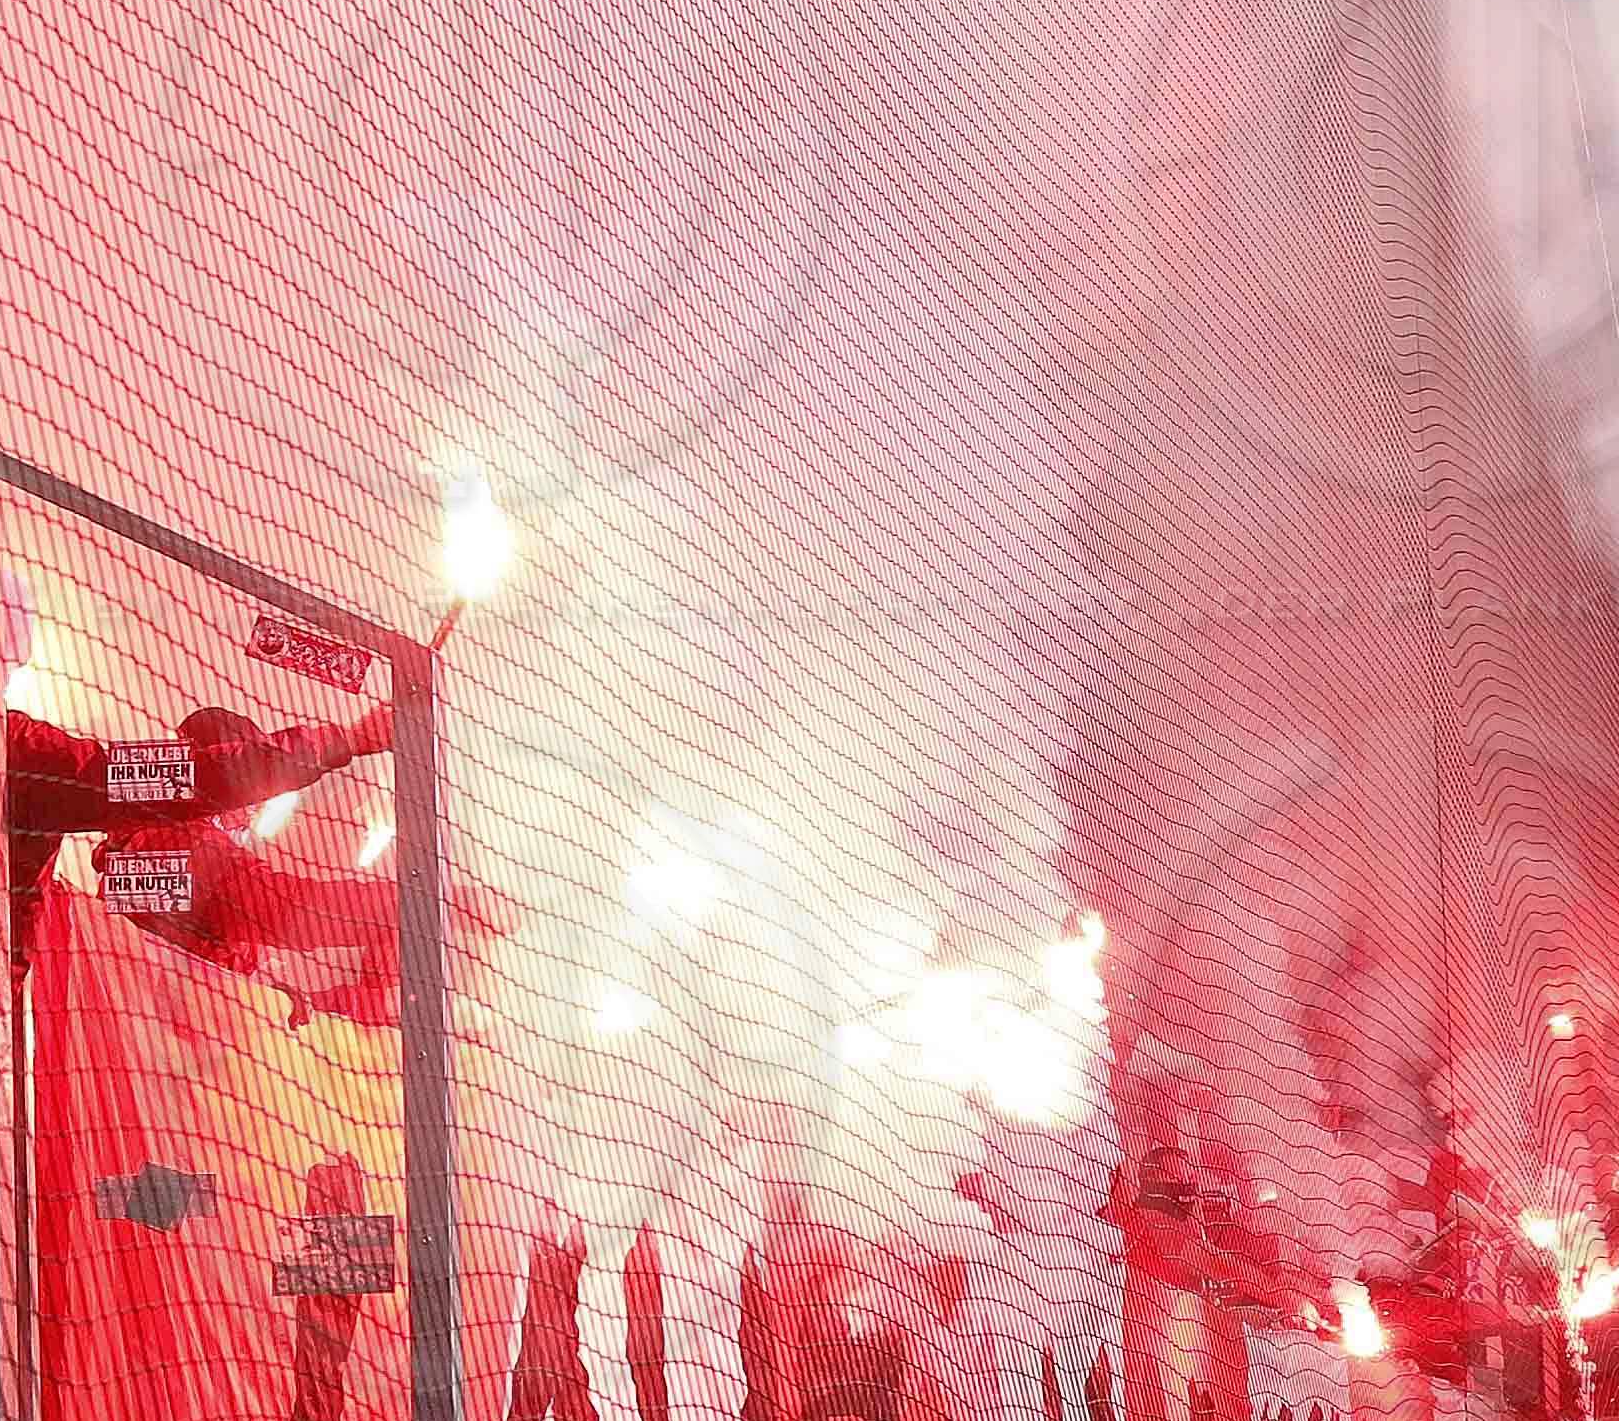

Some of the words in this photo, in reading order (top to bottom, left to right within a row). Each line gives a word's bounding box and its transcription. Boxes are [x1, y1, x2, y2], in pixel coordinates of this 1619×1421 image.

[110, 765, 135, 781] IHR
[138, 762, 191, 780] NUTTEN
[108, 877, 132, 892] IHR
[135, 874, 188, 892] NUTTEN
